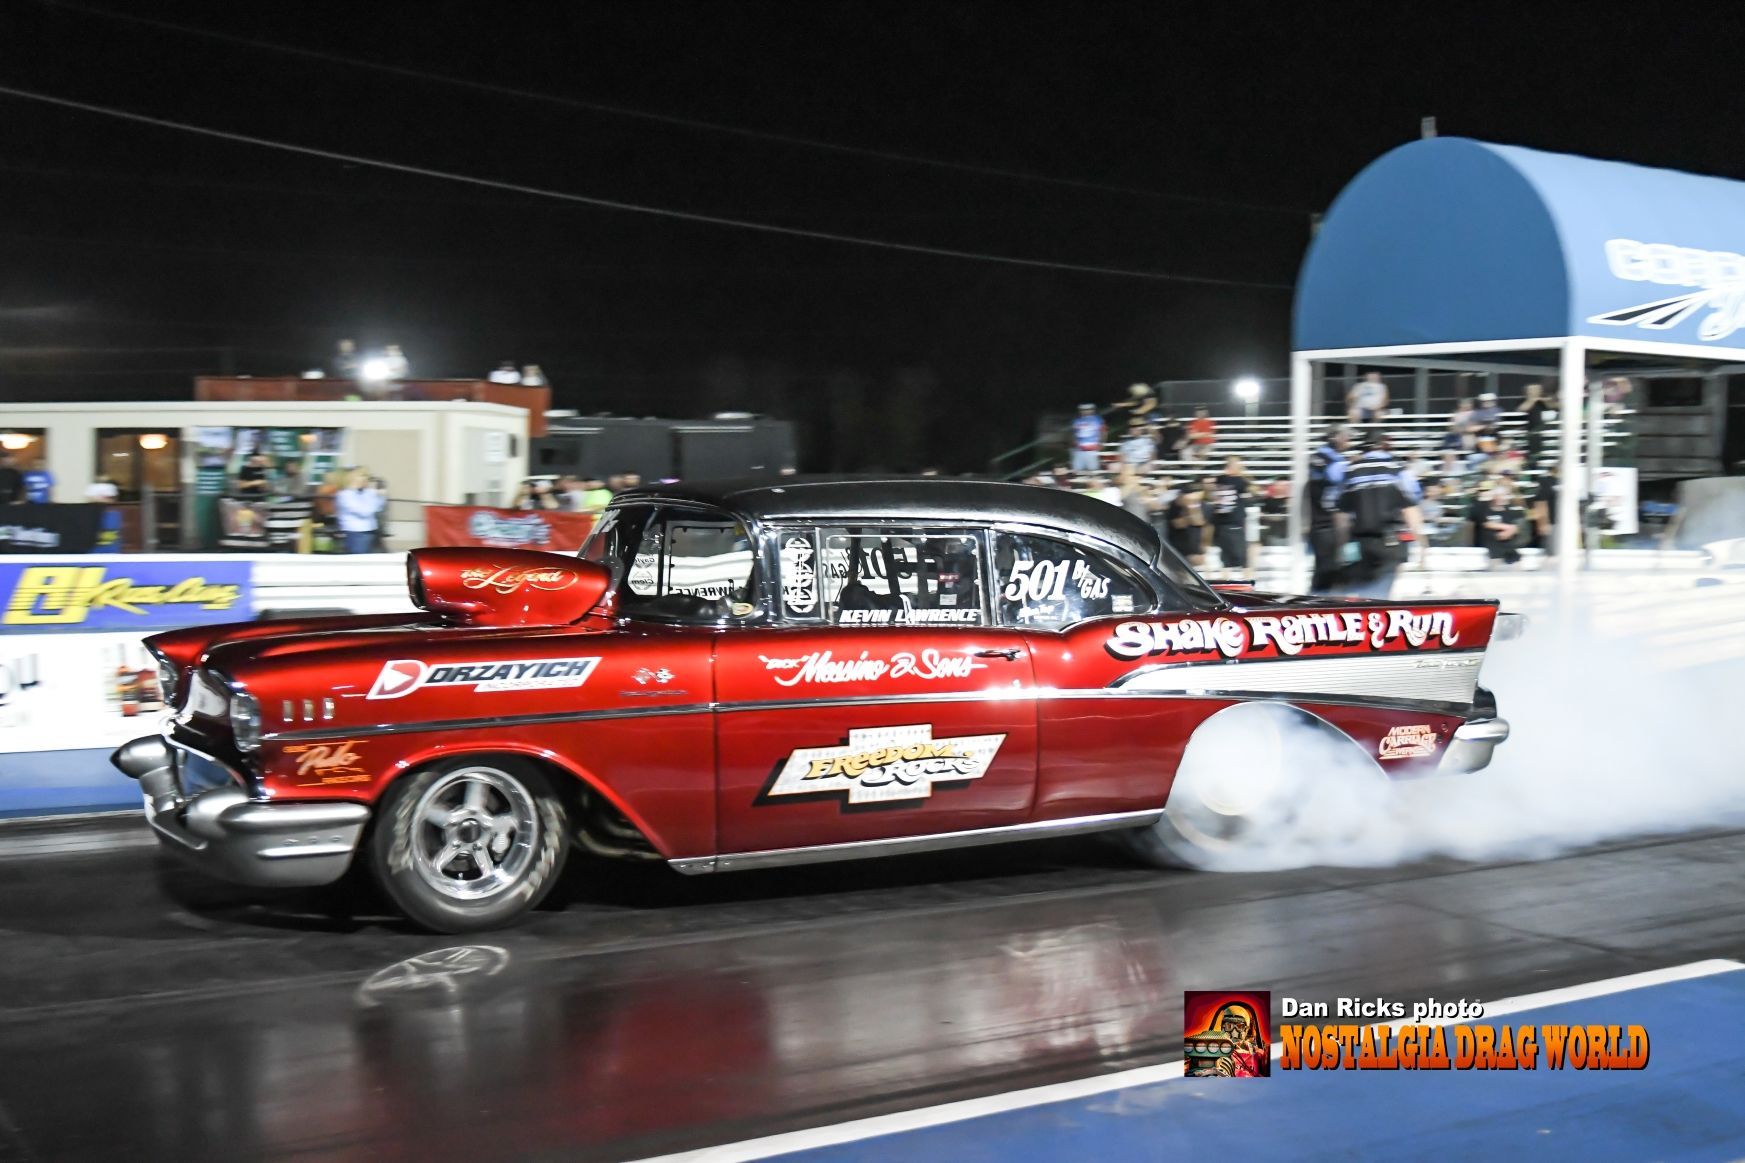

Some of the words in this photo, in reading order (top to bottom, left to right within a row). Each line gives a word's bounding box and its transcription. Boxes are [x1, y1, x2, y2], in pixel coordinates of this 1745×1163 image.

[1005, 560, 1070, 601] 501
[839, 609, 892, 622] KEVIN
[894, 609, 978, 624] LAWRENCE
[914, 649, 988, 679] Sons
[1388, 724, 1431, 736] MODERN
